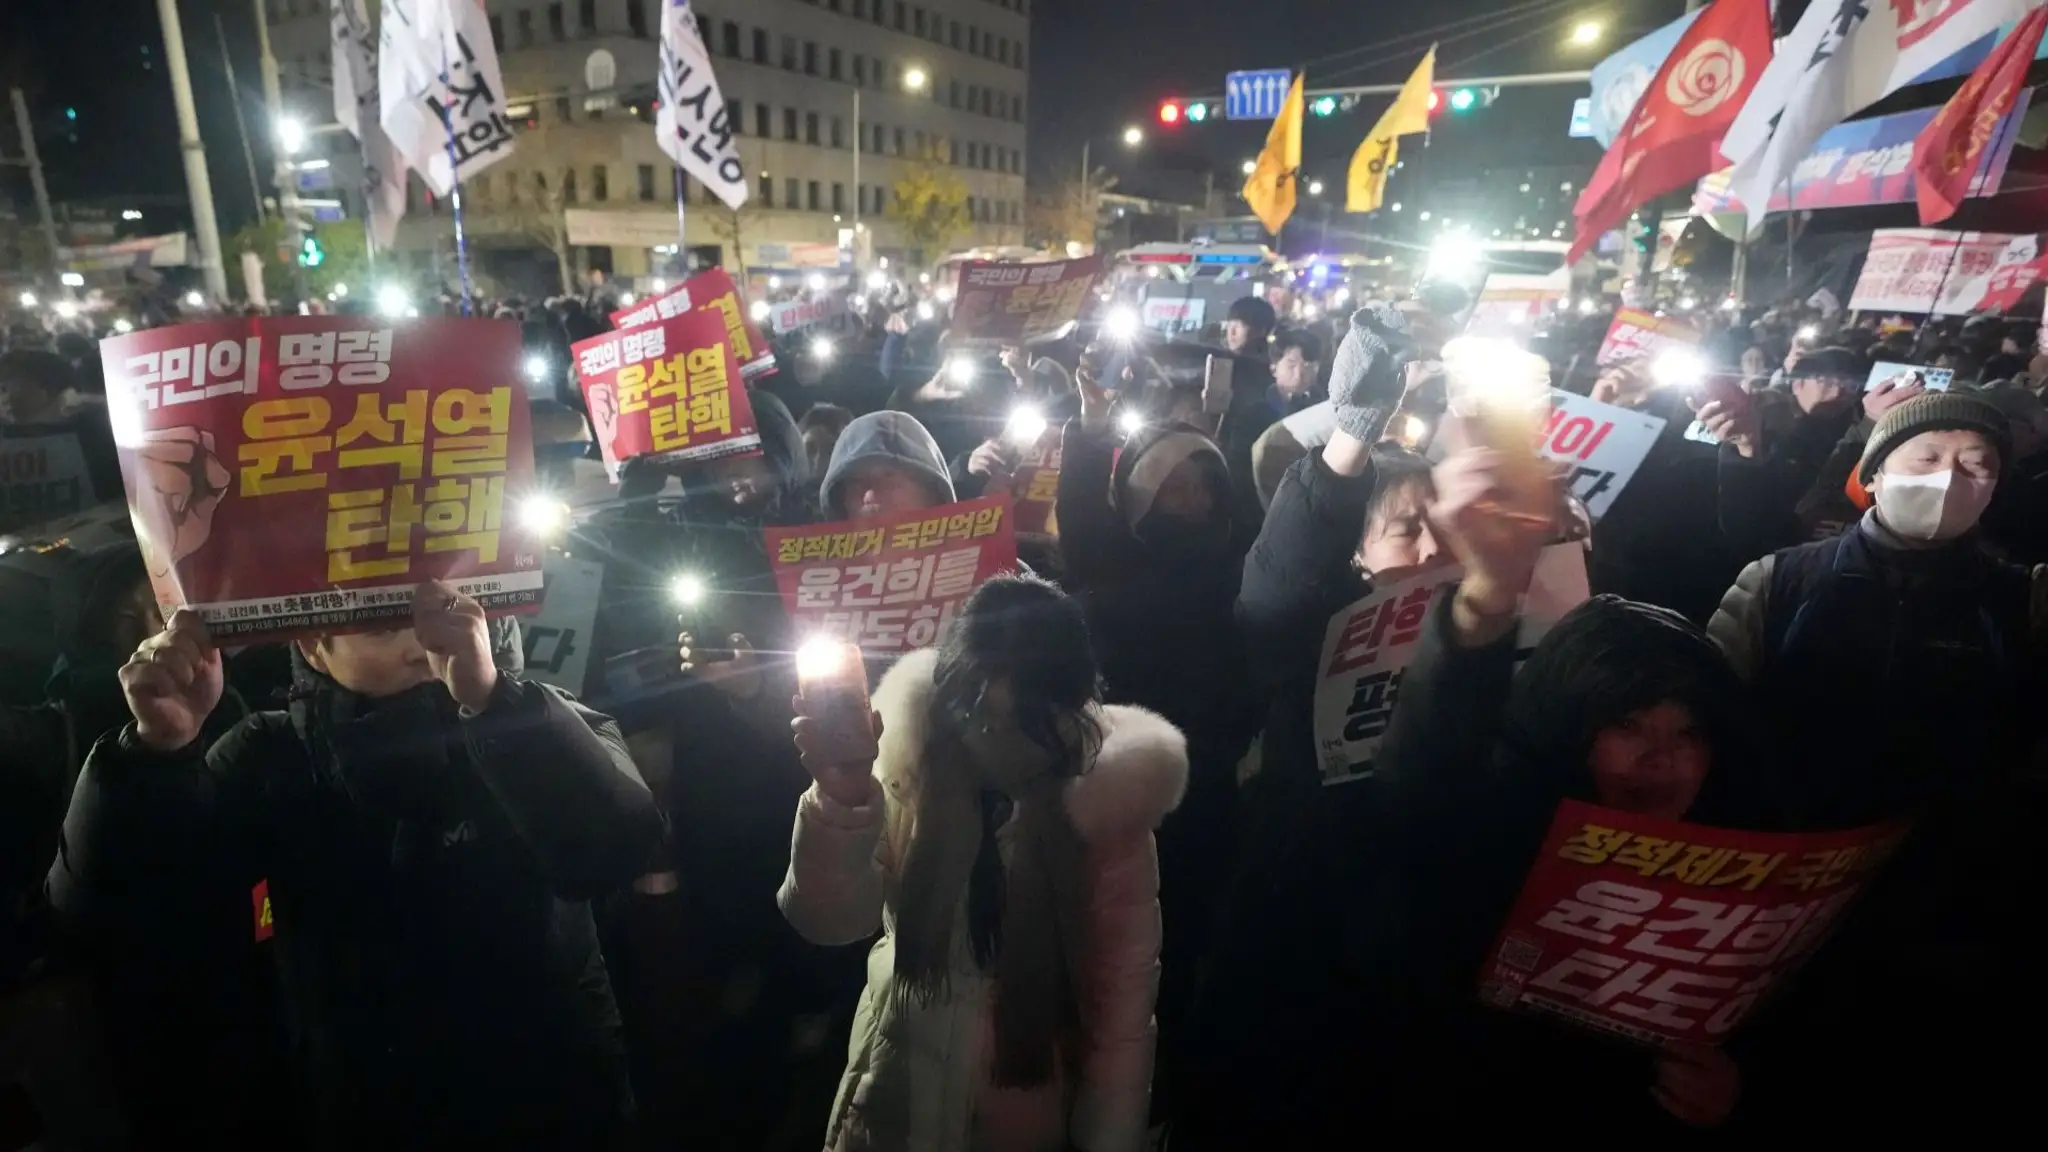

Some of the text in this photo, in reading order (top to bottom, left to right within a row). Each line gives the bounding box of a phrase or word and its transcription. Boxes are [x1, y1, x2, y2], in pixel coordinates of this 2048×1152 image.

[968, 267, 1027, 286] 국민의
[125, 329, 394, 412] 국민의 명령
[580, 339, 620, 376] 국민의
[622, 326, 666, 364] 명령
[616, 342, 728, 415] 윤석열
[238, 387, 512, 498] 윤석열
[649, 389, 732, 452] 탄핵
[326, 476, 506, 582] 탄핵
[778, 506, 1003, 562] 정적제거 국민억압
[797, 546, 981, 608] 윤건희를
[819, 600, 958, 648] 타도하
[1558, 823, 1788, 891] 정적제거
[1535, 880, 1848, 967] 윤건희
